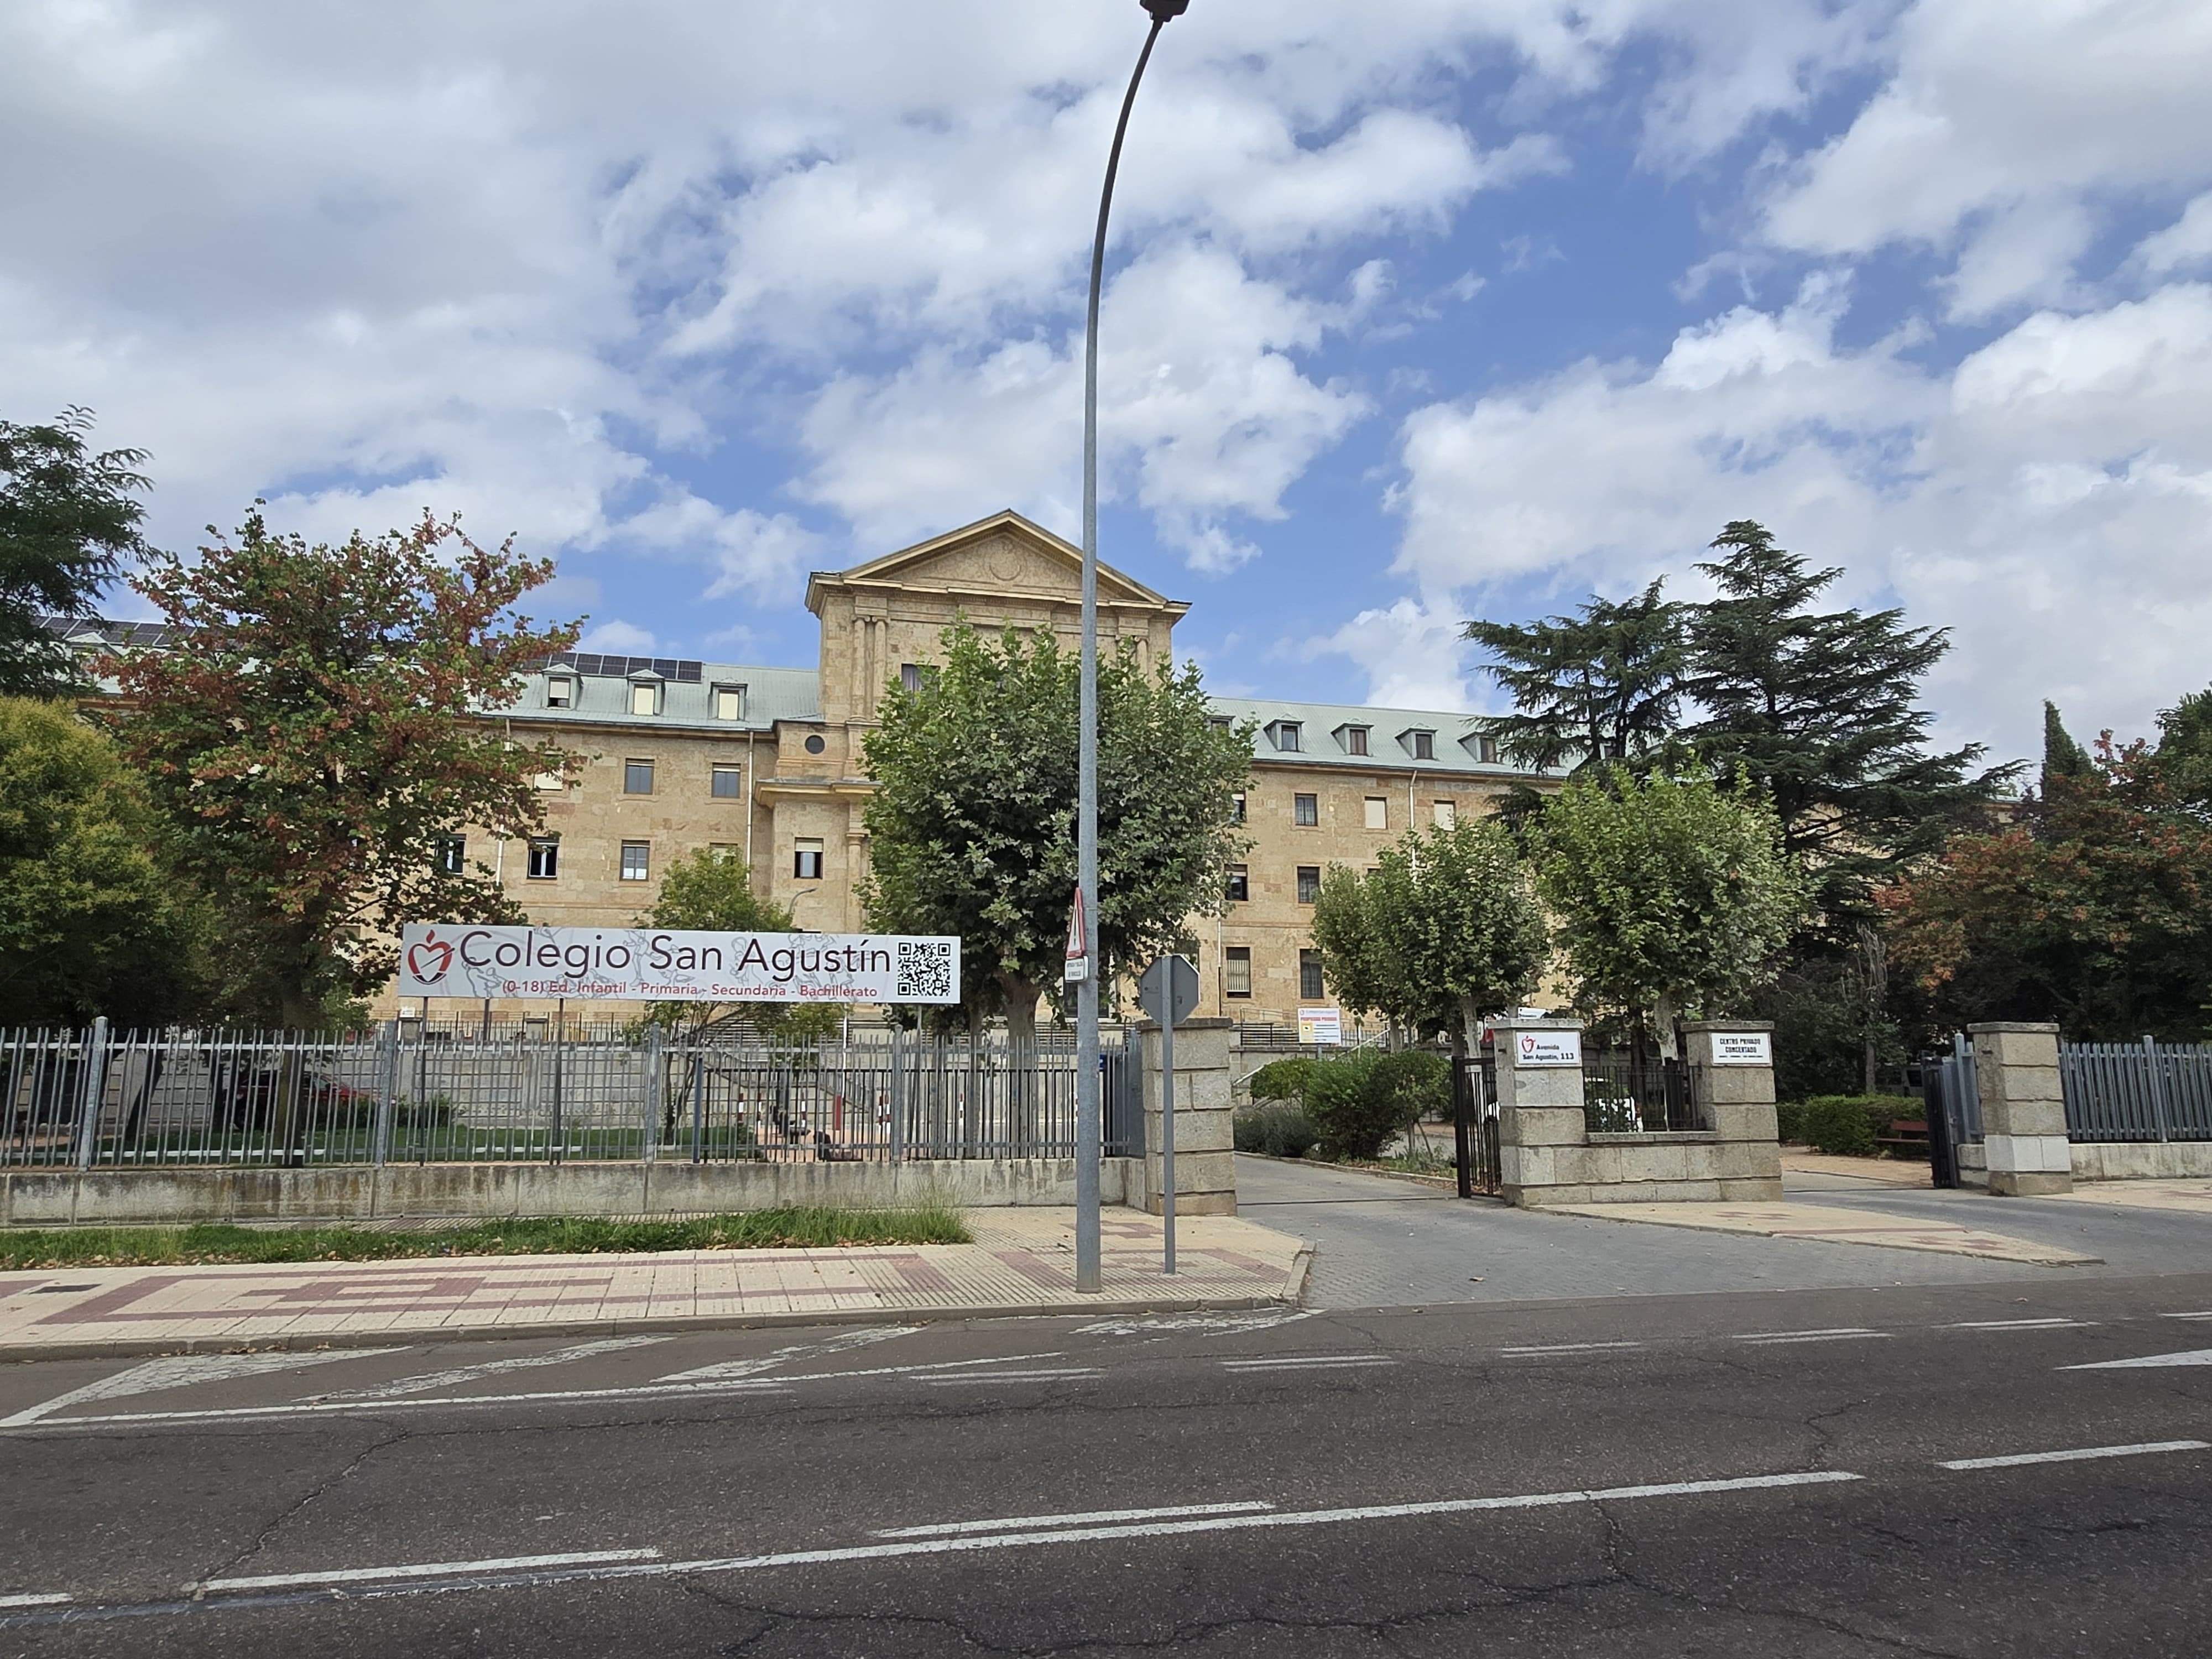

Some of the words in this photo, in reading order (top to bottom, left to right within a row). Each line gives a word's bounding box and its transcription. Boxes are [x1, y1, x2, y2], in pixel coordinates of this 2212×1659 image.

[460, 931, 630, 979] Colegio
[650, 935, 722, 971] San
[737, 938, 890, 982] Agustín
[502, 980, 544, 994] (0-18)
[577, 981, 627, 993] Infantil
[640, 983, 697, 994] Primaria
[711, 984, 786, 996] Secundaria
[800, 985, 878, 997] Bachillerato
